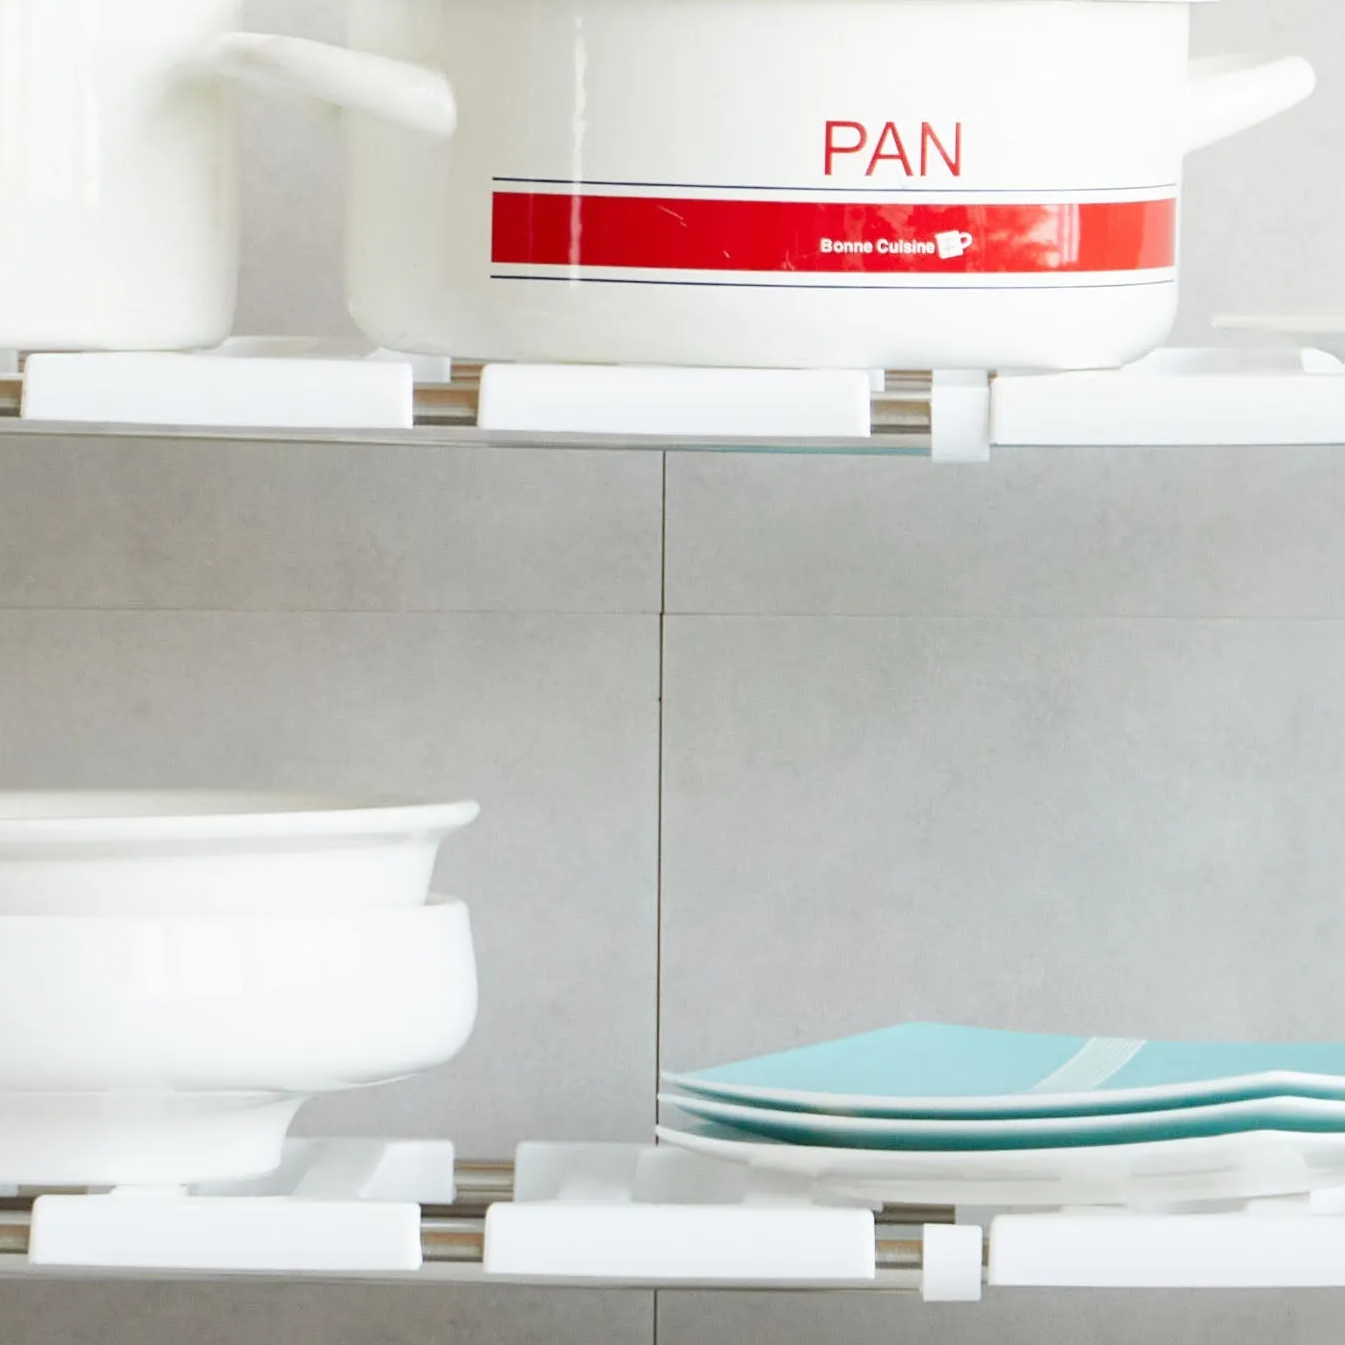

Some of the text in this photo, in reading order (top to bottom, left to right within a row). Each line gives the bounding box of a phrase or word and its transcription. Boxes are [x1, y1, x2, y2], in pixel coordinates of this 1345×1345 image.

[824, 120, 962, 177] PAN
[820, 237, 935, 254] Bonne Cuisine
